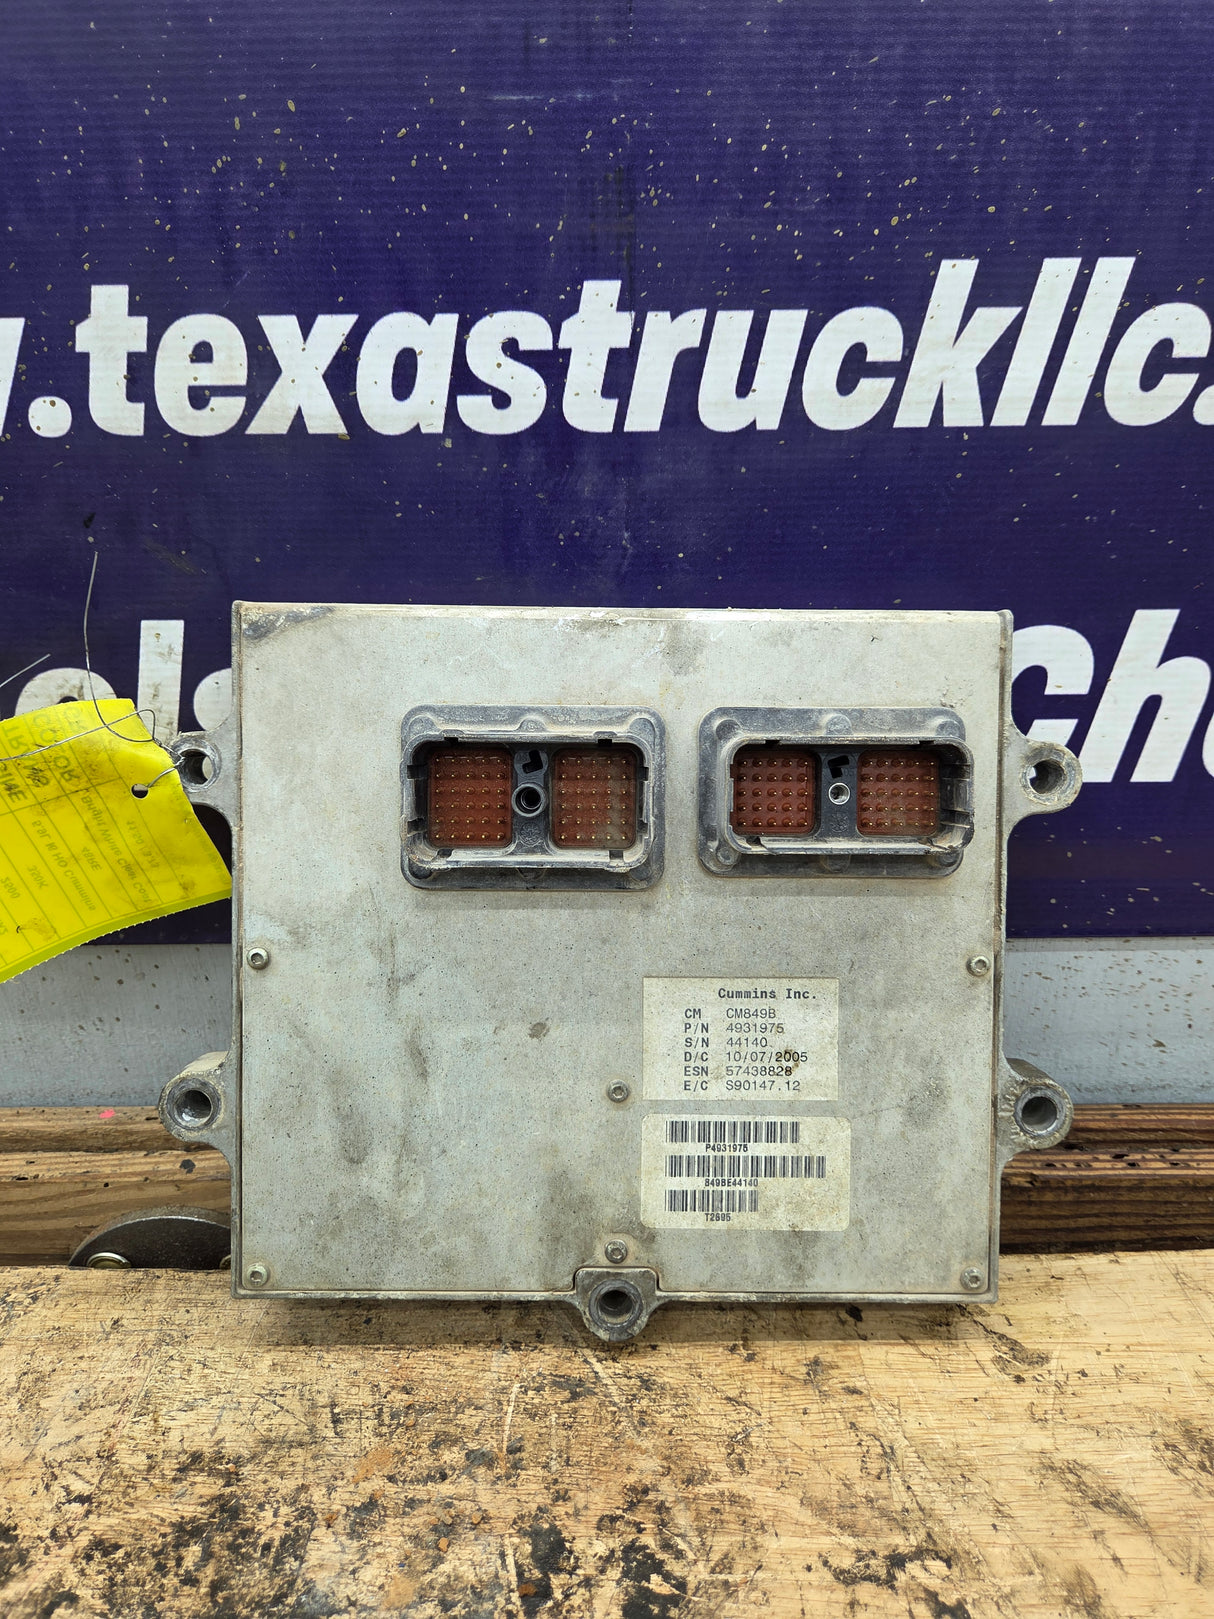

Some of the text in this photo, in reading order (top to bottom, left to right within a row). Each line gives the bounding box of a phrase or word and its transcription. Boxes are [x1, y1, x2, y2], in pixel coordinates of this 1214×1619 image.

[1012, 609, 1214, 783] Ch
[718, 987, 818, 999] Cummins Inc.
[684, 1007, 776, 1019] CM CM849B
[684, 1022, 785, 1034] P/N 4931975
[684, 1037, 768, 1048] S/N 44140
[684, 1051, 808, 1063] D/C 10/07/2005
[684, 1066, 793, 1077] ESN 57438828
[683, 1080, 801, 1092] E/C S90147.12
[705, 1143, 748, 1153] P4931975
